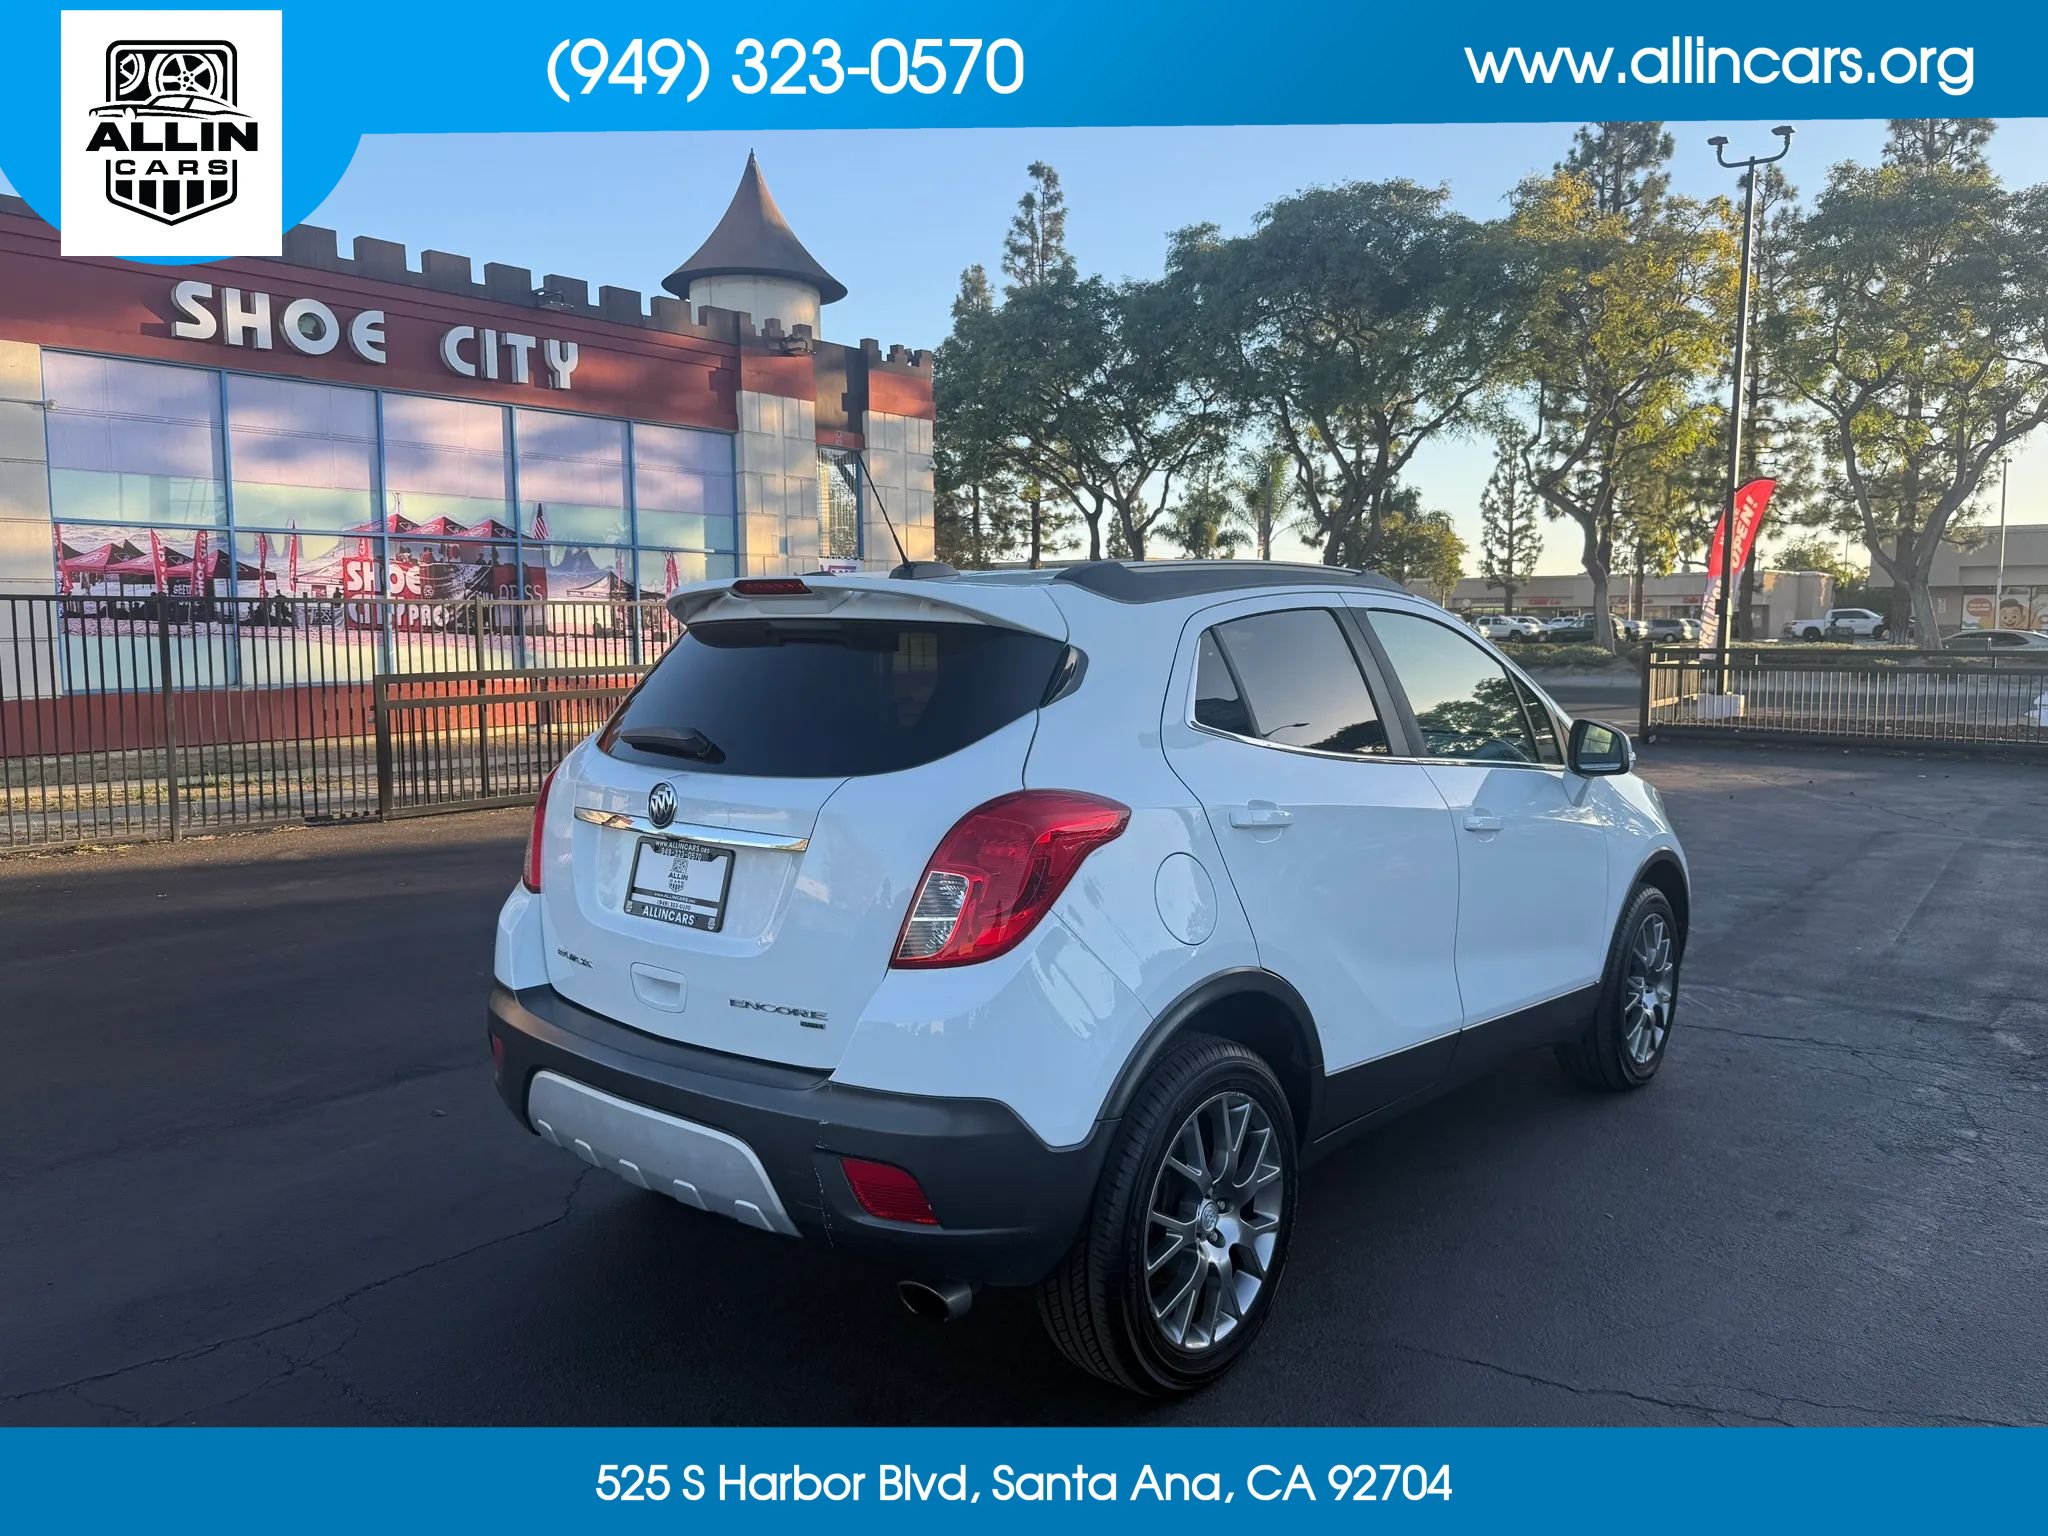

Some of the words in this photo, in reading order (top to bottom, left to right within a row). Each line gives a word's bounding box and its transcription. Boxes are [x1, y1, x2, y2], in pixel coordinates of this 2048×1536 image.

[171, 280, 387, 364] SHOE
[440, 325, 579, 390] CITY
[346, 560, 422, 595] SHOE
[668, 871, 688, 880] ALLIN
[642, 905, 696, 926] ALLINCARS
[729, 998, 829, 1021] ENCORE
